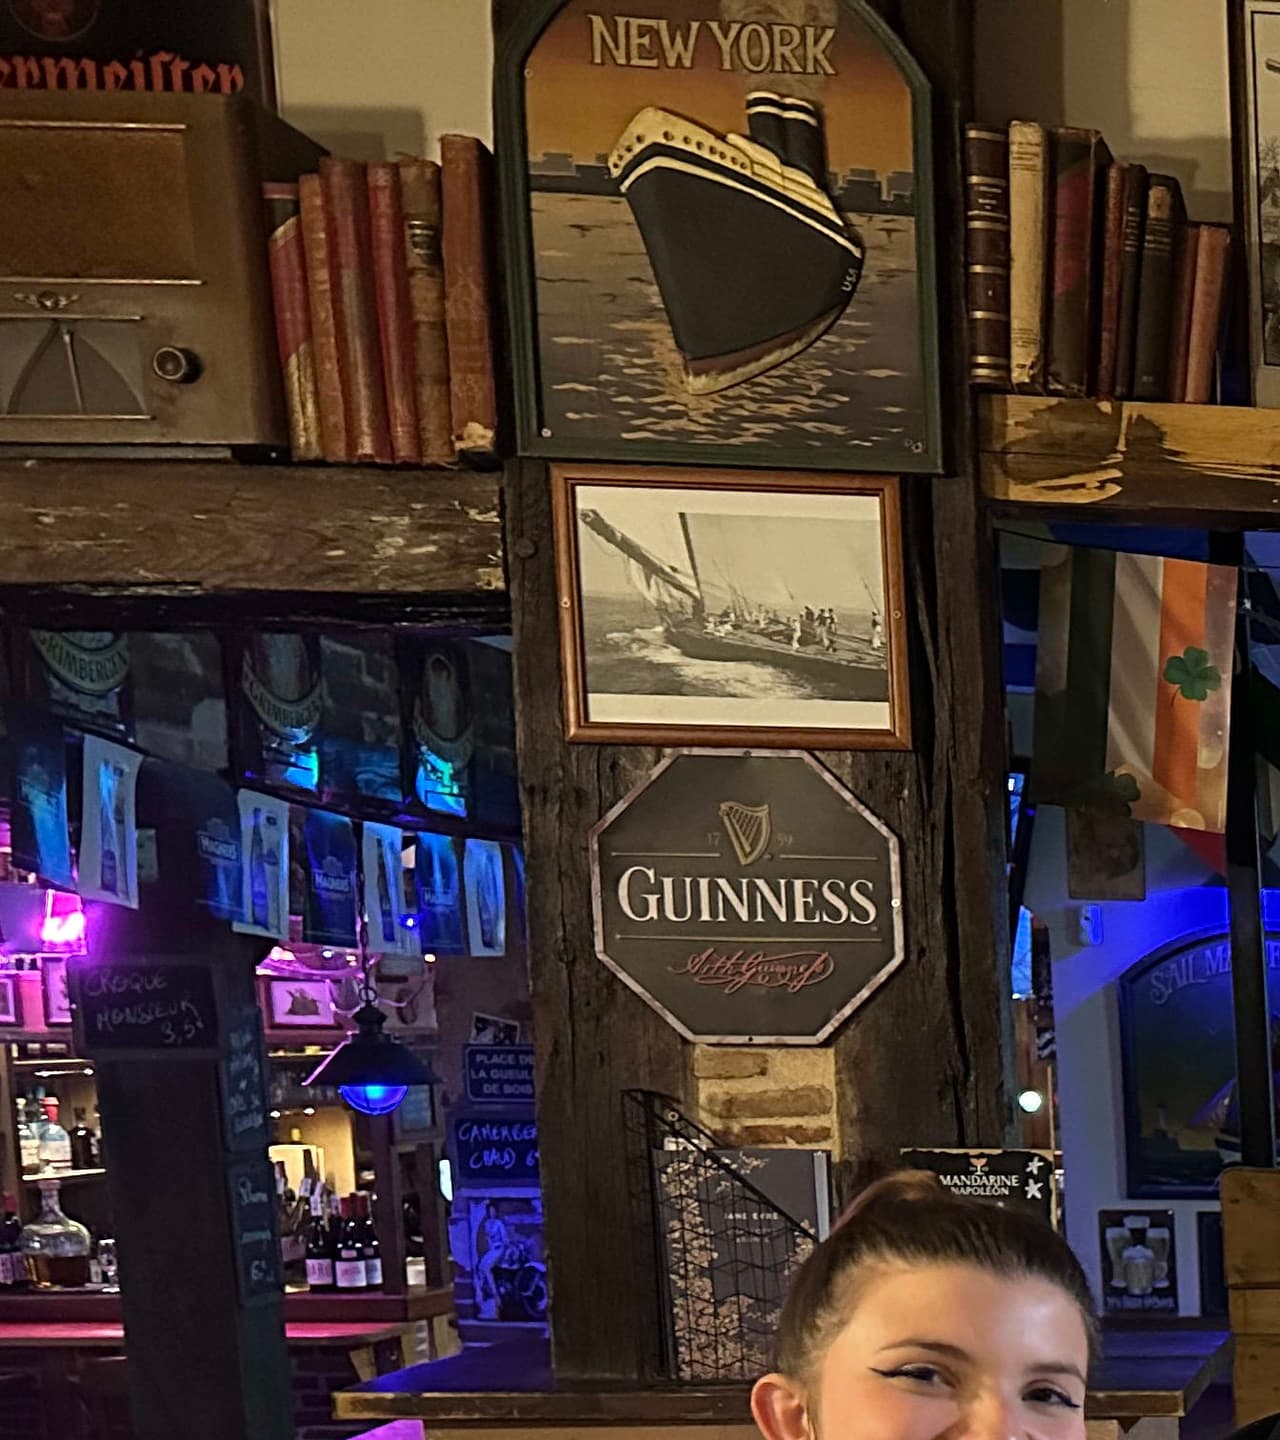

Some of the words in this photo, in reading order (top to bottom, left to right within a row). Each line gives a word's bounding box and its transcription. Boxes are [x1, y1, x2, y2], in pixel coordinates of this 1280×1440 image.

[588, 14, 700, 69] NEW
[707, 20, 837, 75] YORK
[617, 866, 879, 925] GUINNESS
[84, 968, 168, 997] CROQUE
[1151, 956, 1208, 1006] SAIL
[490, 1069, 535, 1080] GUEUL
[939, 1175, 1020, 1187] MANDARINE
